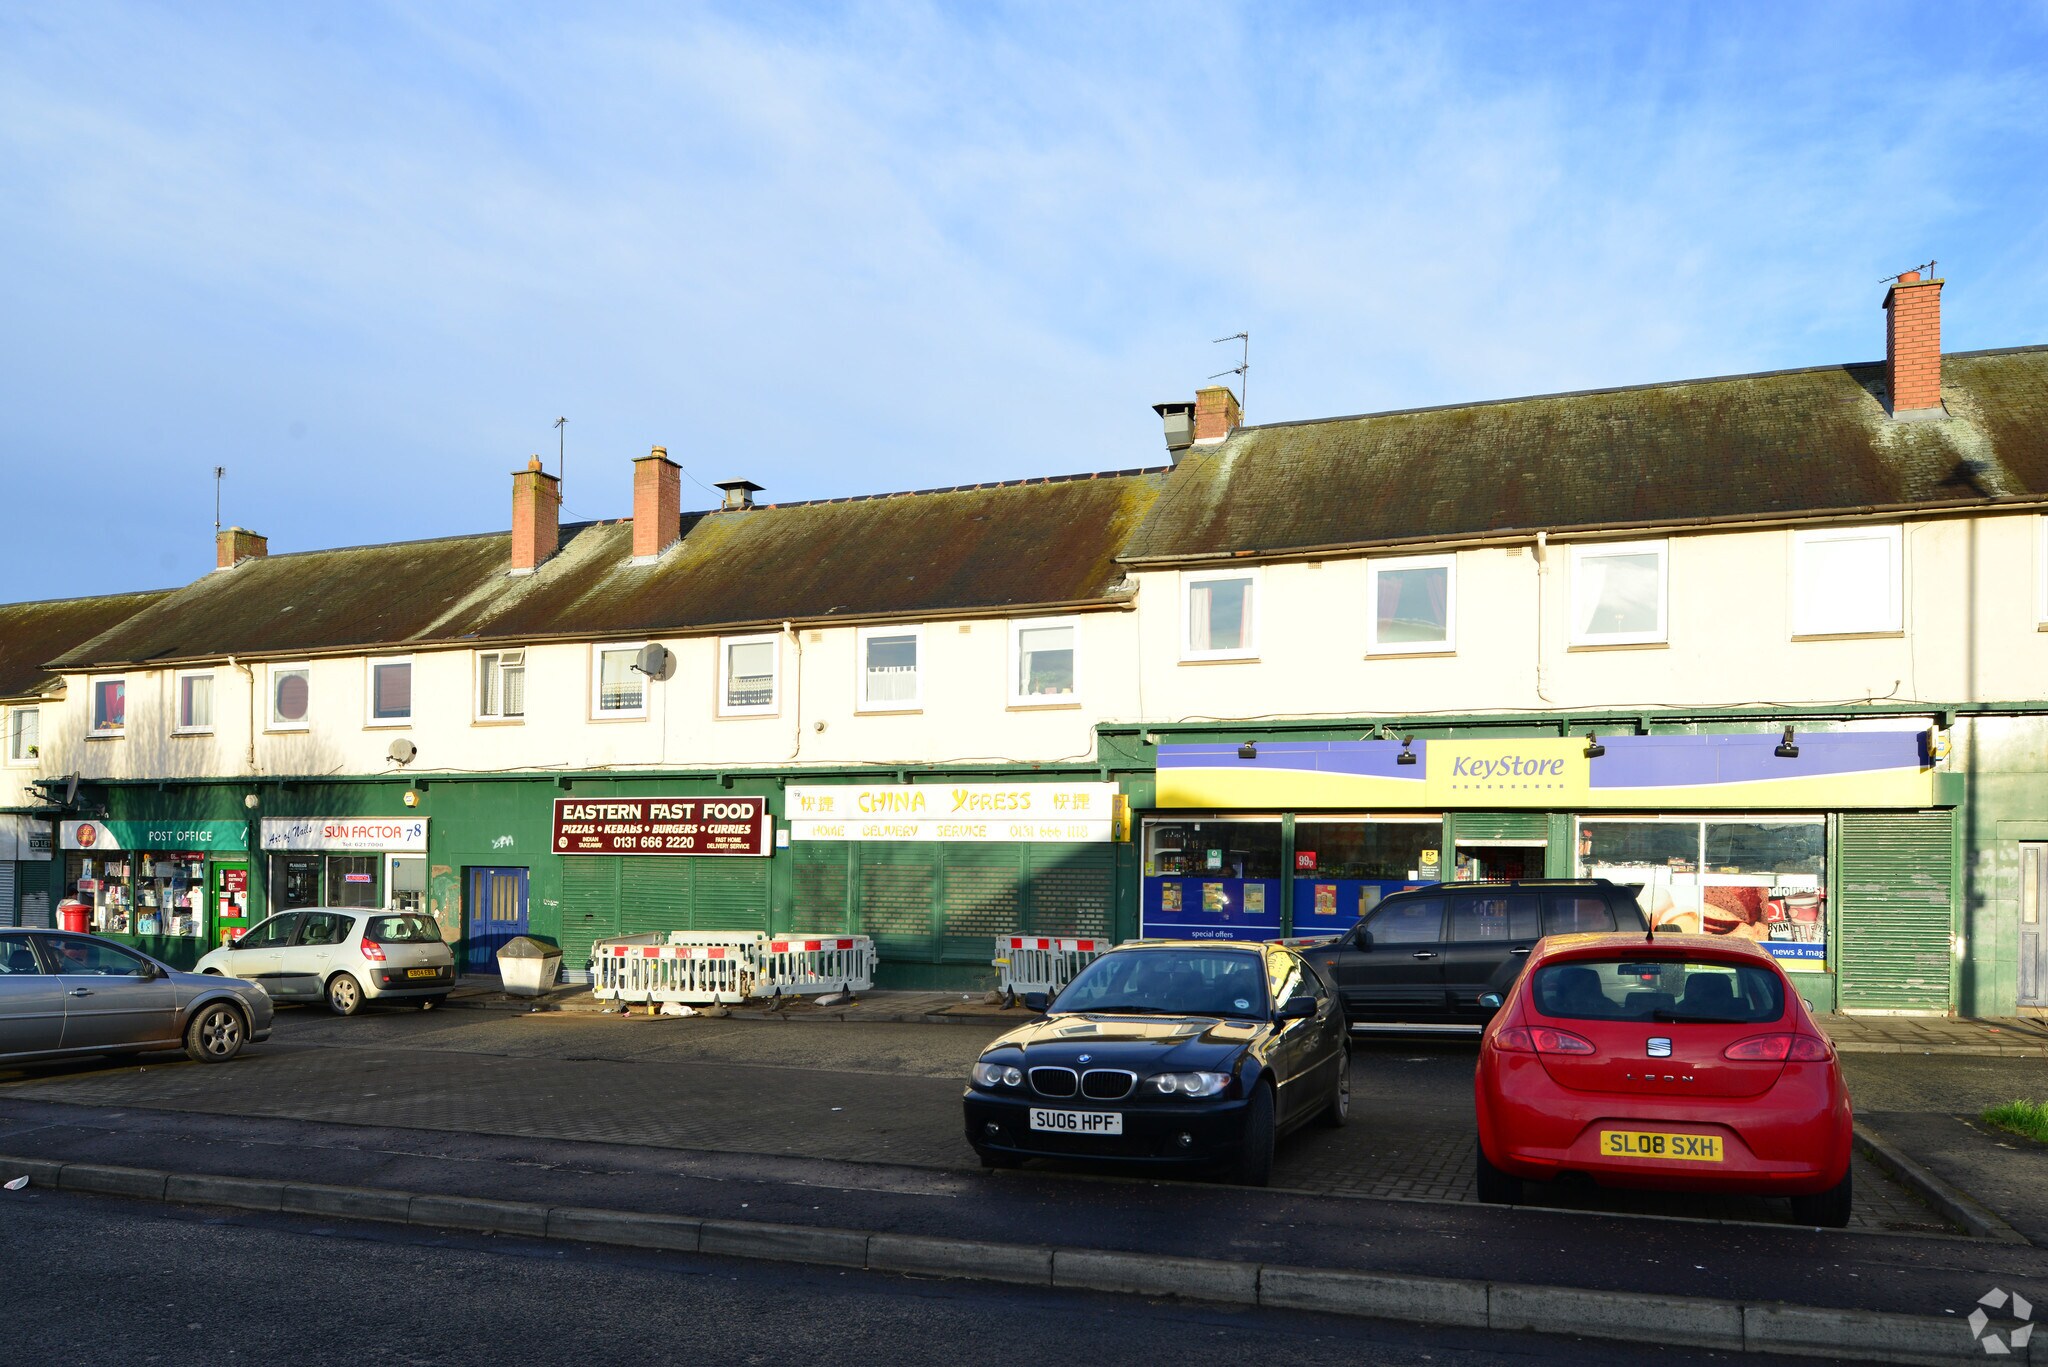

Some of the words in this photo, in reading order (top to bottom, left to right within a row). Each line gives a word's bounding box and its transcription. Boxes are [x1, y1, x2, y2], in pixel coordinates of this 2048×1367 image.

[1452, 755, 1565, 780] KeyStore
[801, 795, 835, 812] 快捷
[858, 790, 926, 813] CHINA
[951, 788, 1032, 813] XPRESS
[1053, 792, 1090, 810] 快捷
[562, 804, 642, 820] EASTERN
[649, 803, 696, 819] FAST
[703, 803, 755, 820] FOOD
[149, 831, 173, 841] POST
[176, 831, 212, 841] OFFICE
[268, 833, 281, 846] Art
[292, 824, 313, 838] Nails
[324, 825, 349, 838] SUN
[352, 825, 402, 838] FACTOR
[405, 823, 422, 842] 78
[561, 824, 595, 834] PIZZAS
[603, 824, 643, 834] KEBABS
[651, 824, 698, 834] BURGERS
[707, 824, 752, 835] CURRIES
[812, 825, 845, 837] HOME
[862, 825, 918, 837] DELIVERY
[937, 825, 987, 838] SERVICE
[1009, 825, 1034, 838] 0131
[613, 836, 637, 848] 0131
[640, 836, 663, 848] 666
[665, 836, 695, 849] 2220
[1298, 855, 1314, 868] 99p
[1191, 930, 1214, 939] special
[1214, 930, 1234, 939] offers
[1796, 948, 1804, 956] &
[1626, 1073, 1694, 1082] LEON
[1036, 1112, 1077, 1130] SU06
[1081, 1114, 1115, 1131] HPF
[1610, 1134, 1666, 1155] SL08
[1671, 1137, 1714, 1157] SXH
